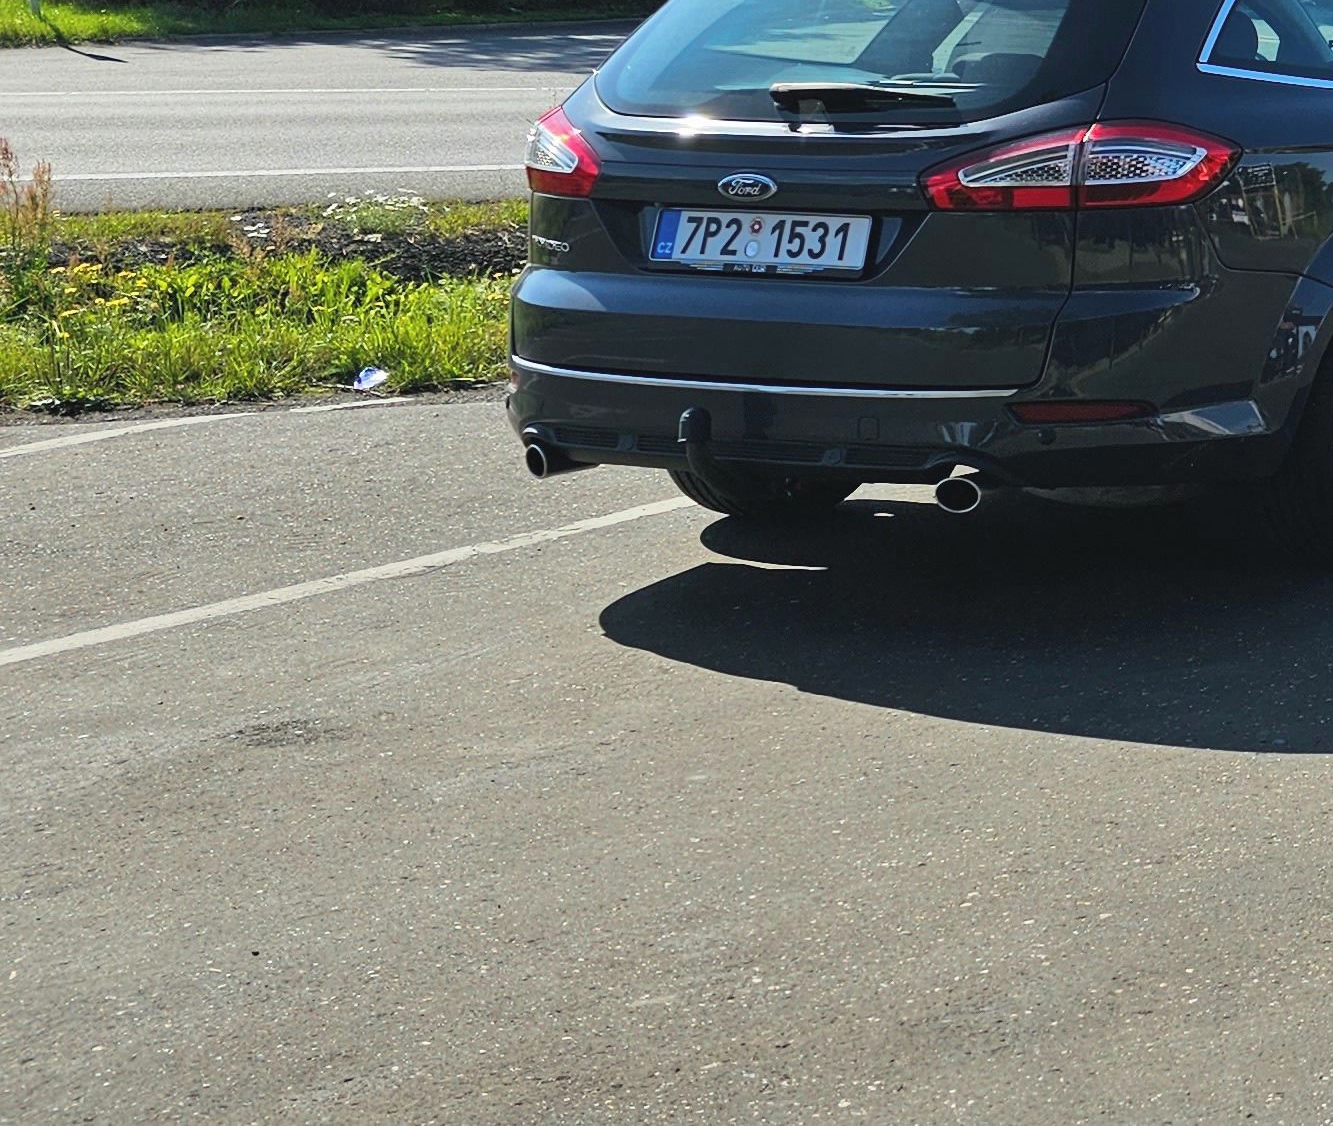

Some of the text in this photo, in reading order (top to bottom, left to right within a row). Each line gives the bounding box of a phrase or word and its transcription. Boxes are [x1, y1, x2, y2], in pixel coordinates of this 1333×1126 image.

[728, 178, 762, 195] Ford
[656, 215, 851, 262] CZ 7P2 1531
